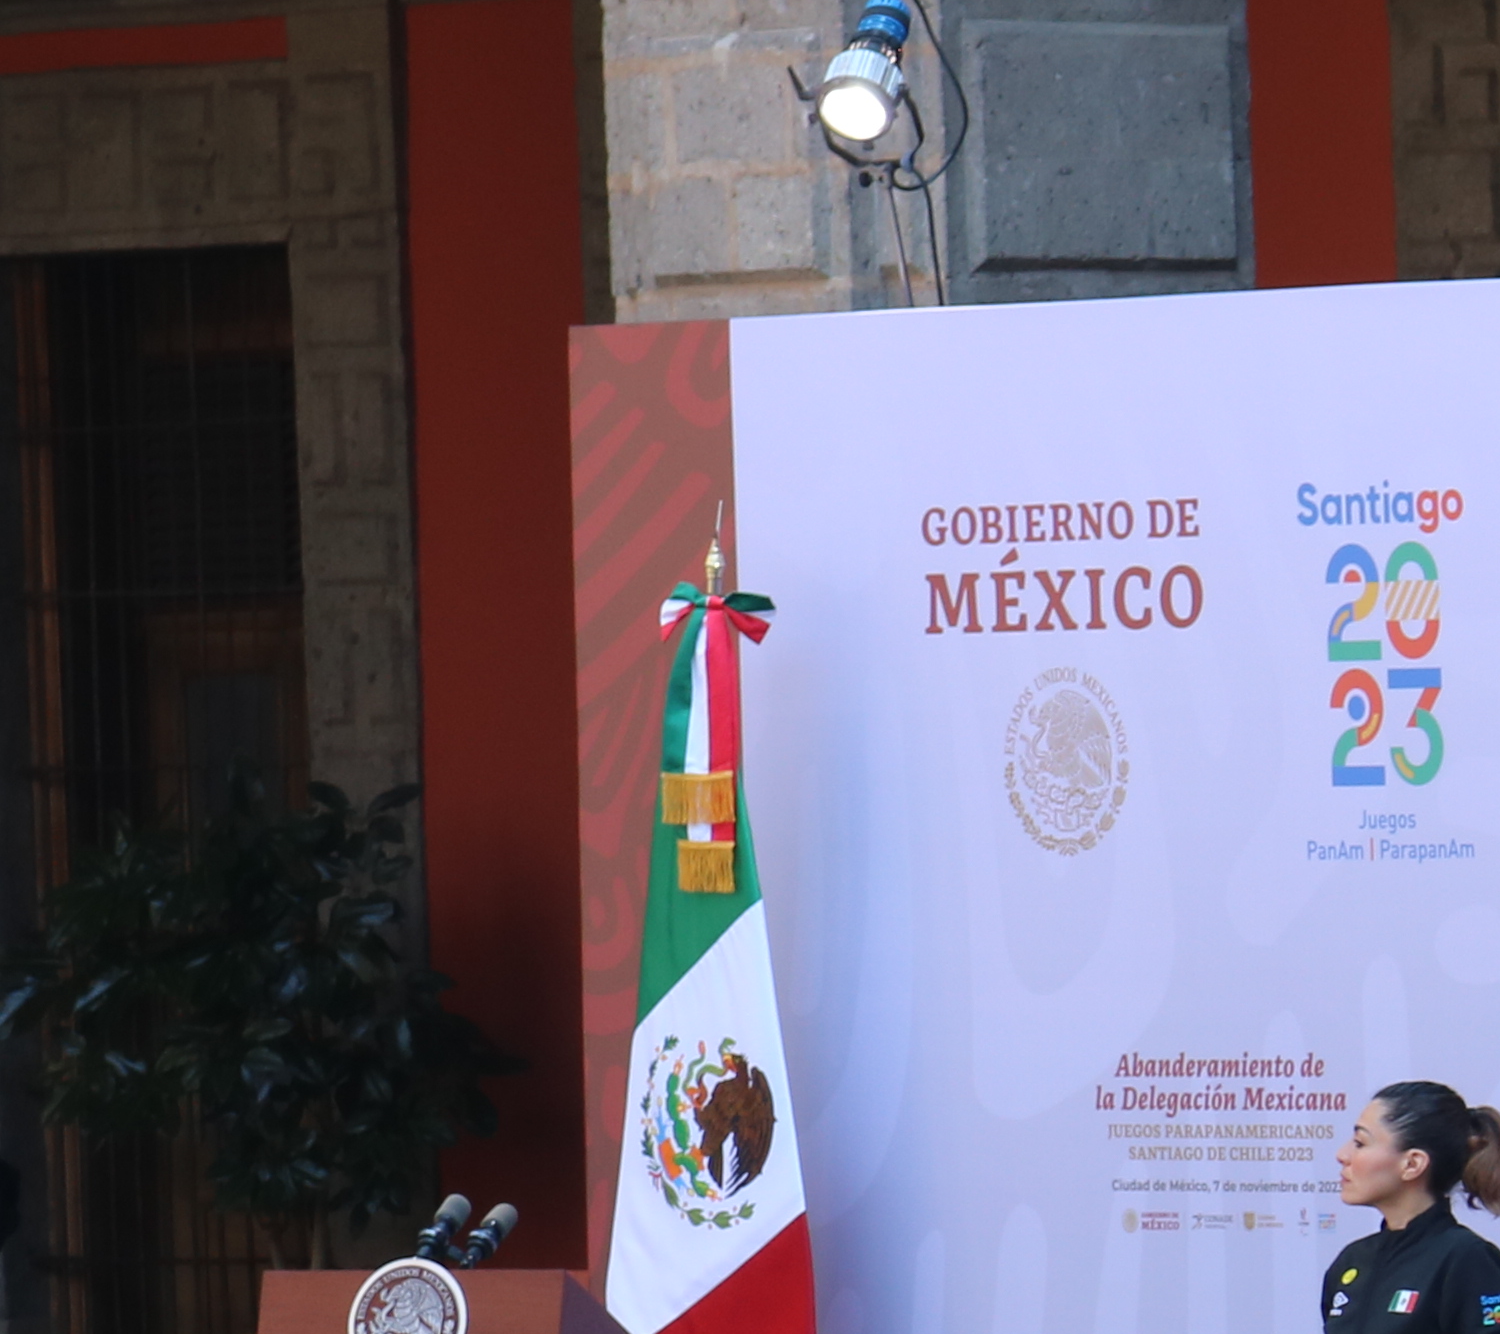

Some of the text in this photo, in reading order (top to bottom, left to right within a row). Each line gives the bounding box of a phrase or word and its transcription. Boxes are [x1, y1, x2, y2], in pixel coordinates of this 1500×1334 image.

[921, 497, 1200, 546] GOBIERNO DE
[1296, 479, 1464, 534] Santiago
[924, 547, 1204, 635] MÉXICO
[1326, 541, 1441, 661] 20
[1330, 667, 1444, 787] 23
[1358, 809, 1418, 833] Juegos
[1307, 838, 1476, 864] PanAm ParapanAm
[1114, 1050, 1325, 1079] Abanderamiento de
[1095, 1083, 1347, 1119] la Delegación Mexicana
[1107, 1124, 1335, 1140] JUEGOS PARAPANAMERICANOS
[1128, 1146, 1314, 1161] SANTIAGO DE CHILE 2023
[1111, 1179, 1151, 1192] Ciudad
[1152, 1180, 1167, 1192] de
[1169, 1179, 1211, 1194] México,
[1212, 1181, 1221, 1192] 7
[1222, 1180, 1237, 1193] de
[1239, 1180, 1300, 1193] noviembre
[1301, 1180, 1316, 1193] de
